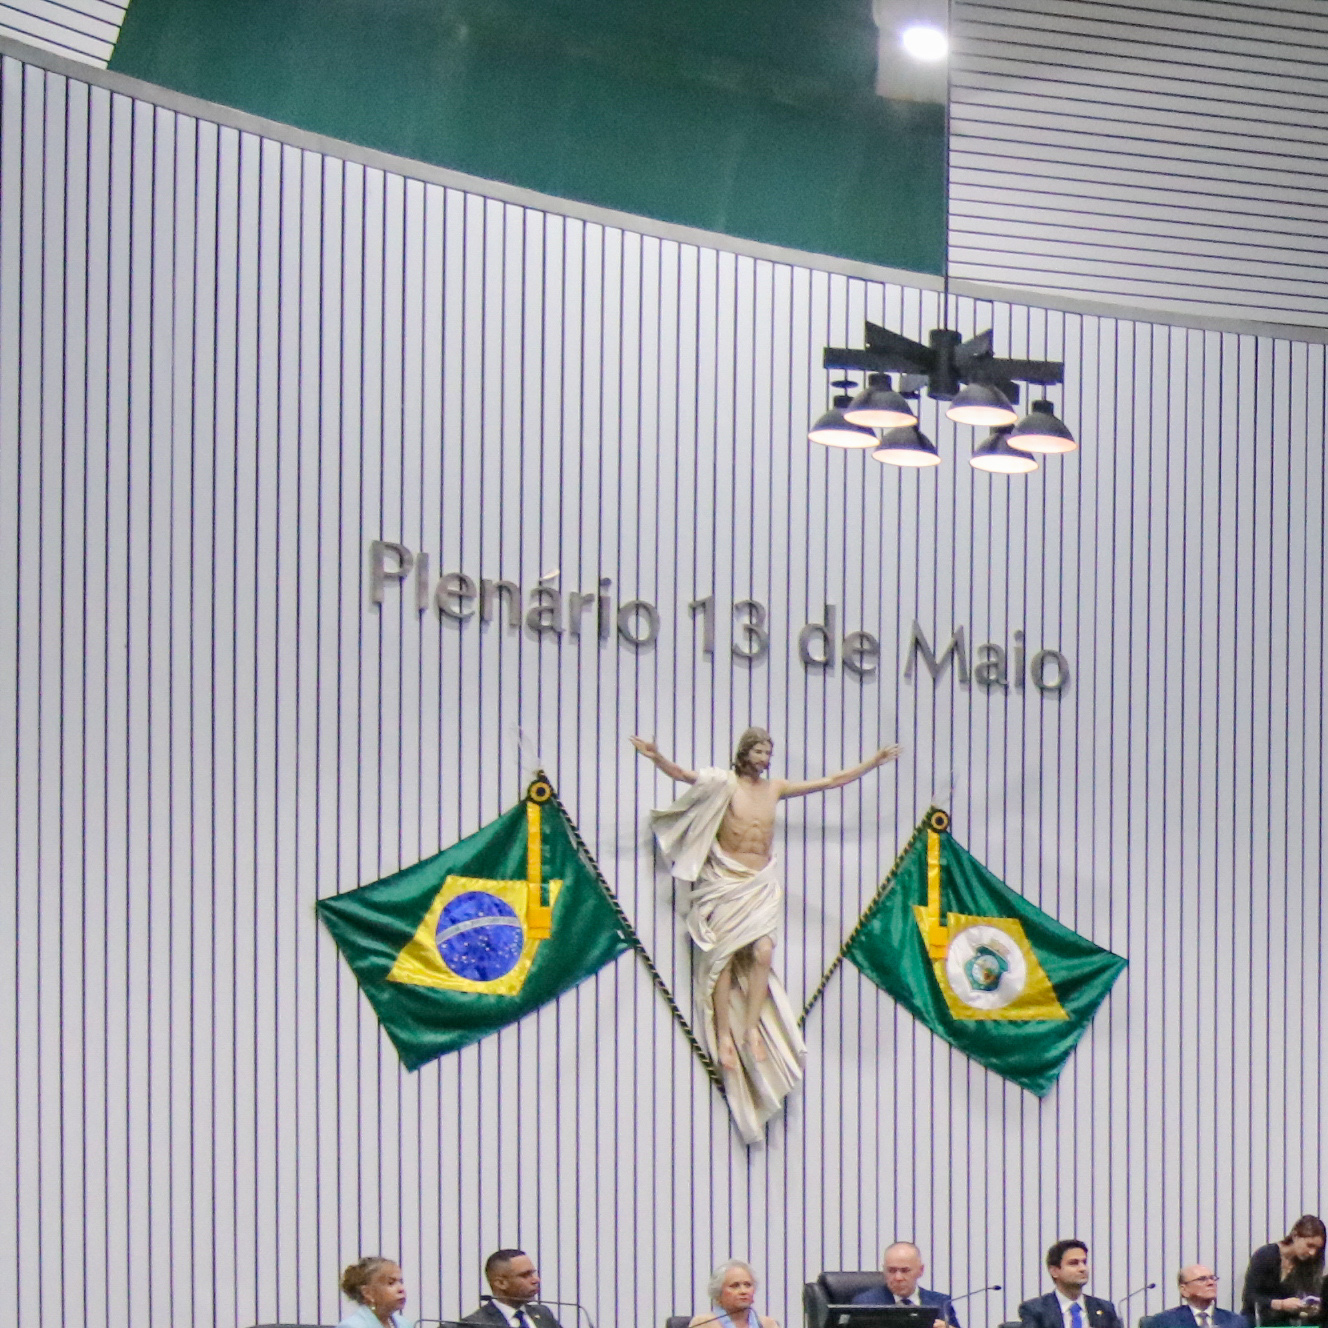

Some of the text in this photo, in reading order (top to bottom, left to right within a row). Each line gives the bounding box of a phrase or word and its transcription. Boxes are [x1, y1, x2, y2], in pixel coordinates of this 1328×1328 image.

[369, 540, 1071, 692] Plenário 13 de Maio
